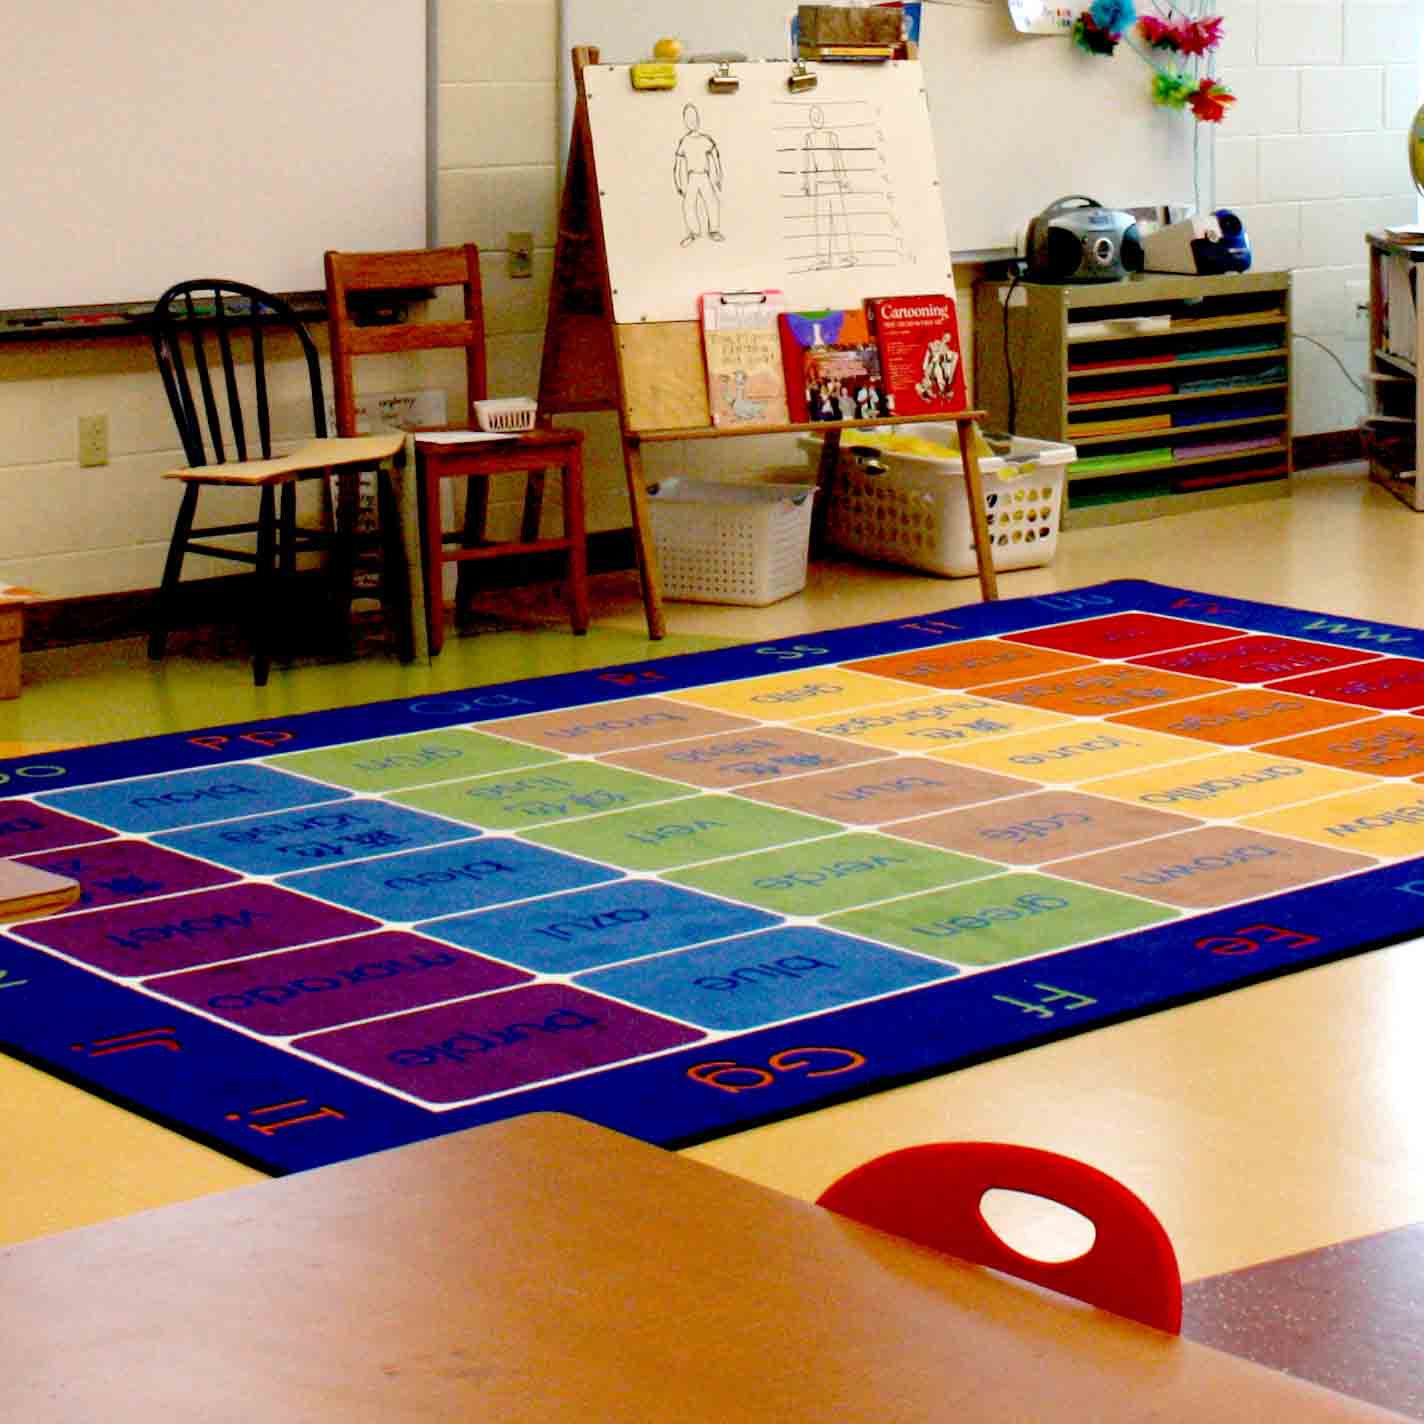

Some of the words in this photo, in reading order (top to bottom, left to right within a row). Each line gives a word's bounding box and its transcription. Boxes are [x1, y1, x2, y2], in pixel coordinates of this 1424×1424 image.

[880, 303, 950, 321] Cartooning
[753, 643, 831, 664] Ss
[185, 729, 295, 753] Pp
[1138, 763, 1305, 805] amarillo
[623, 816, 729, 846] vert
[752, 851, 909, 892] verde
[1120, 840, 1292, 887] brown
[535, 904, 652, 942] azul
[910, 891, 1070, 940] green
[1192, 923, 1322, 957] Ee
[207, 950, 461, 1011] morado
[695, 951, 842, 994] blue
[991, 981, 1098, 1020] Ff
[69, 1025, 184, 1058] Jj
[386, 1006, 601, 1068] purple
[686, 1045, 868, 1095] Gg
[223, 1098, 347, 1137] Ii
